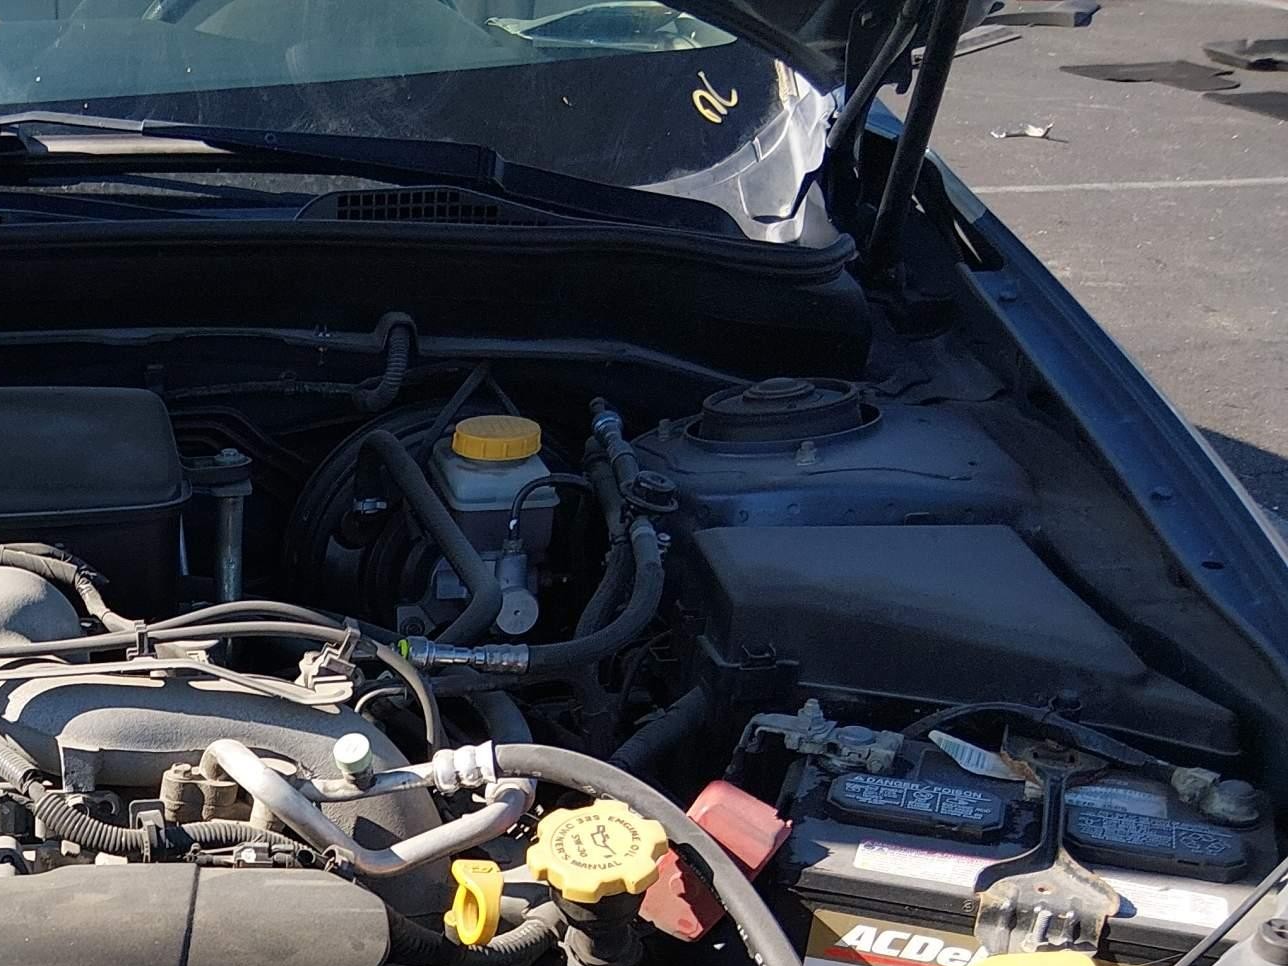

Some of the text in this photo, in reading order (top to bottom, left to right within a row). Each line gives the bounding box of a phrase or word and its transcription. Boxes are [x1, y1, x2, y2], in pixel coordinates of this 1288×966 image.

[865, 777, 920, 791] DANGER
[933, 786, 982, 799] POISON
[554, 822, 575, 862] OWNER'S
[570, 859, 623, 871] MANUAL
[571, 834, 589, 859] 5W-30
[607, 815, 642, 858] ENGINE OIL
